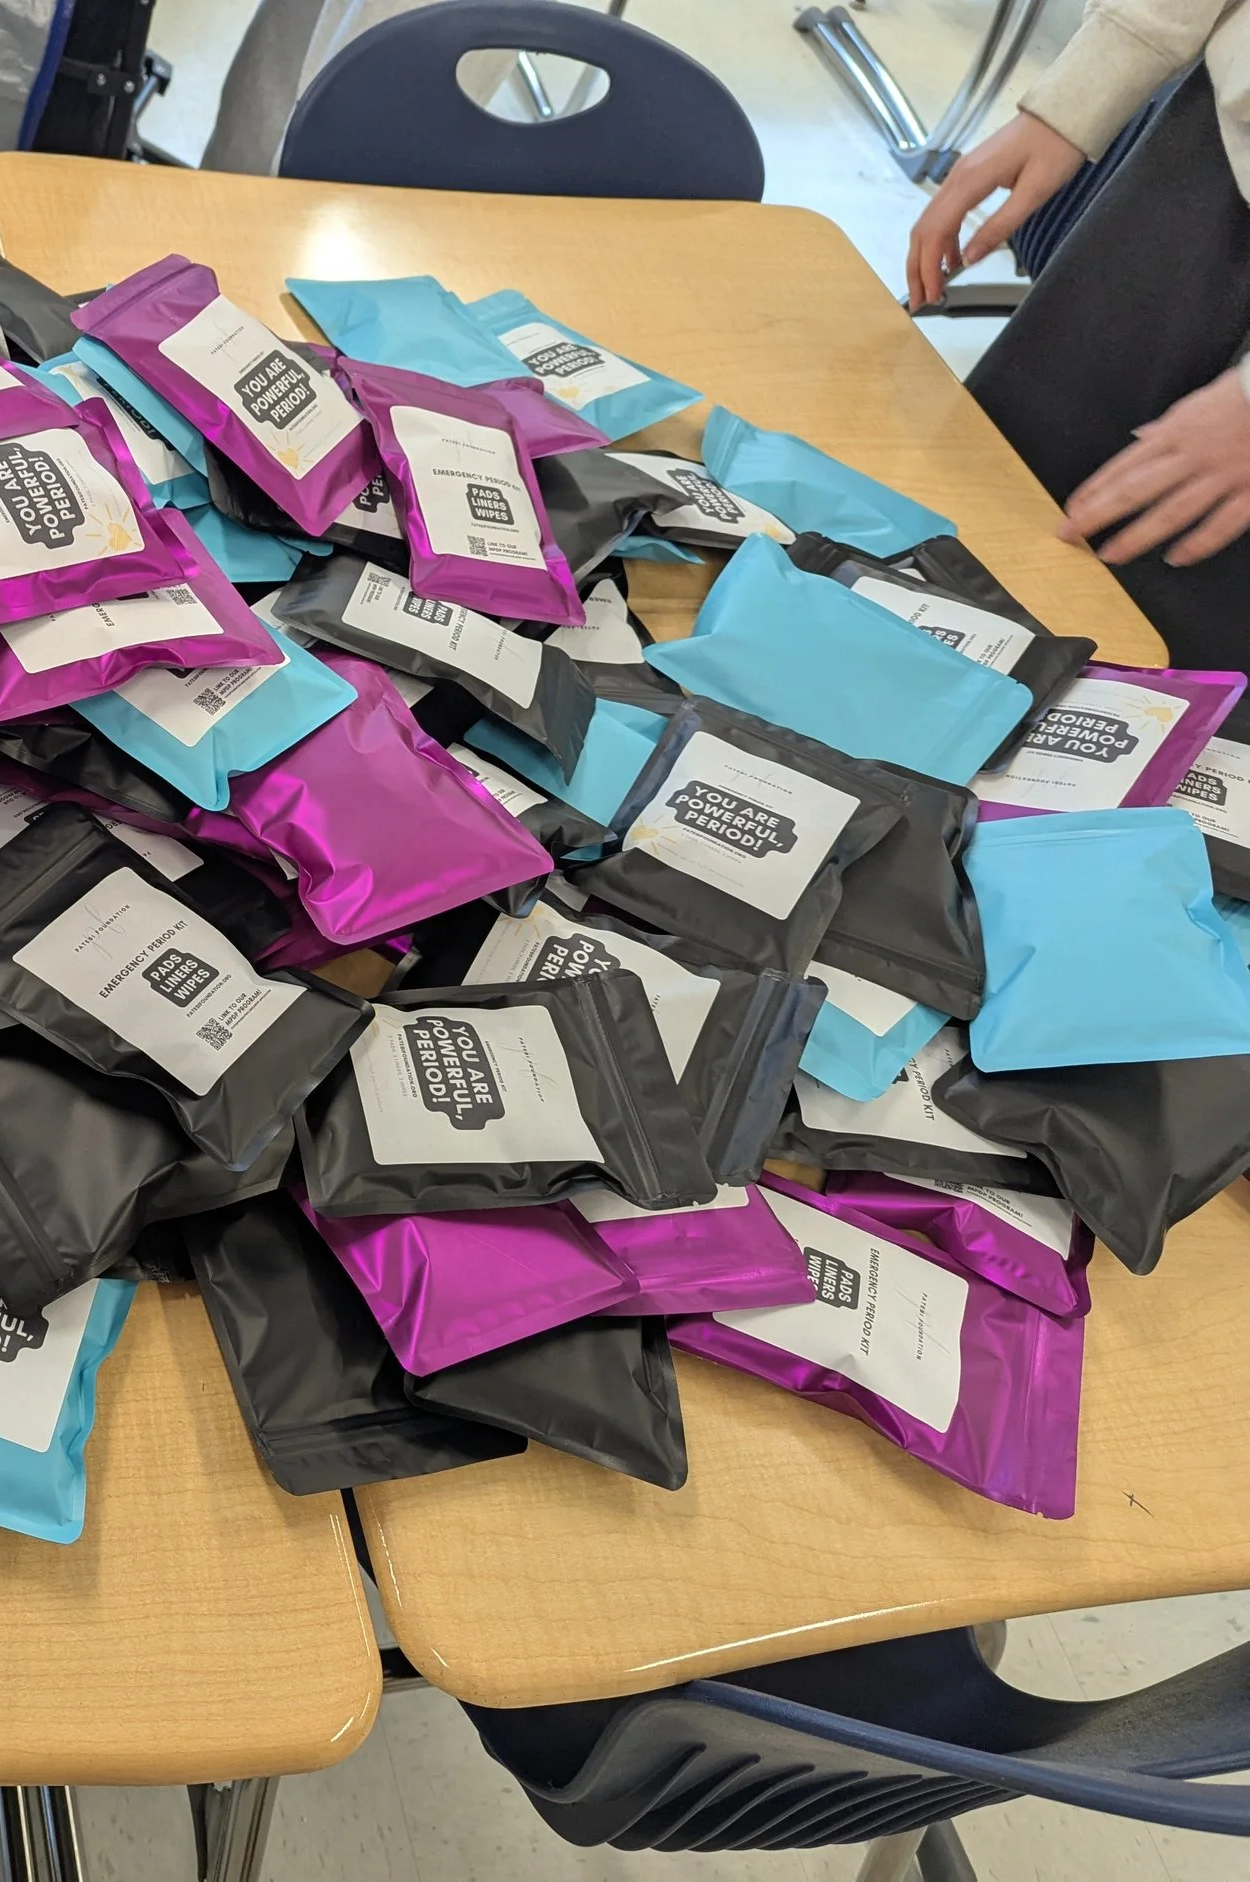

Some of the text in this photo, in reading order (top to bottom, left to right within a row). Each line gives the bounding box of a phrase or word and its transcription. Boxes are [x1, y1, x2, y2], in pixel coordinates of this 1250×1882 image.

[528, 350, 556, 365] YOU
[242, 373, 268, 398] YOU
[268, 358, 286, 379] ARE
[251, 369, 305, 416] POWERFUL,
[270, 383, 310, 423] PERIOD!
[10, 447, 65, 540] POWERFUL,
[34, 457, 76, 520] PERIOD!
[433, 468, 511, 488] EMERGENCY PERIOD
[472, 488, 500, 500] PADS
[12, 496, 42, 536] YOU
[471, 498, 507, 511] LINERS
[476, 508, 508, 521] WIPES
[692, 492, 714, 513] YOU
[434, 604, 448, 622] PADS
[918, 603, 930, 613] KIT
[1048, 713, 1119, 733] PERIOD
[1065, 740, 1108, 758] YOU
[1187, 772, 1217, 786] ADS
[1205, 767, 1244, 782] PERIOD
[675, 794, 784, 848] POWERFUL,
[695, 785, 739, 809] YOU
[740, 807, 780, 828] ARE
[684, 811, 762, 851] PERIOD!
[74, 903, 131, 954] PATESI FOUNDATION
[99, 920, 189, 999] EMERGENCY PERIOD KIT
[150, 952, 182, 981] PADS
[160, 959, 199, 994] LINERS
[174, 968, 210, 1001] WIPES
[218, 1009, 230, 1021] LINK
[236, 993, 247, 1003] OUR
[413, 1029, 451, 1104] PERIOD!
[426, 1018, 473, 1120] POWERFUL,
[451, 1026, 493, 1105] YOU ARE
[914, 1069, 935, 1121] PERIOD KIT
[986, 1195, 1023, 1218] PROGRAM!
[823, 1259, 839, 1302] LINERS
[840, 1268, 855, 1303] PADS
[860, 1248, 881, 1356] EMERGENCY PERIOD KIT
